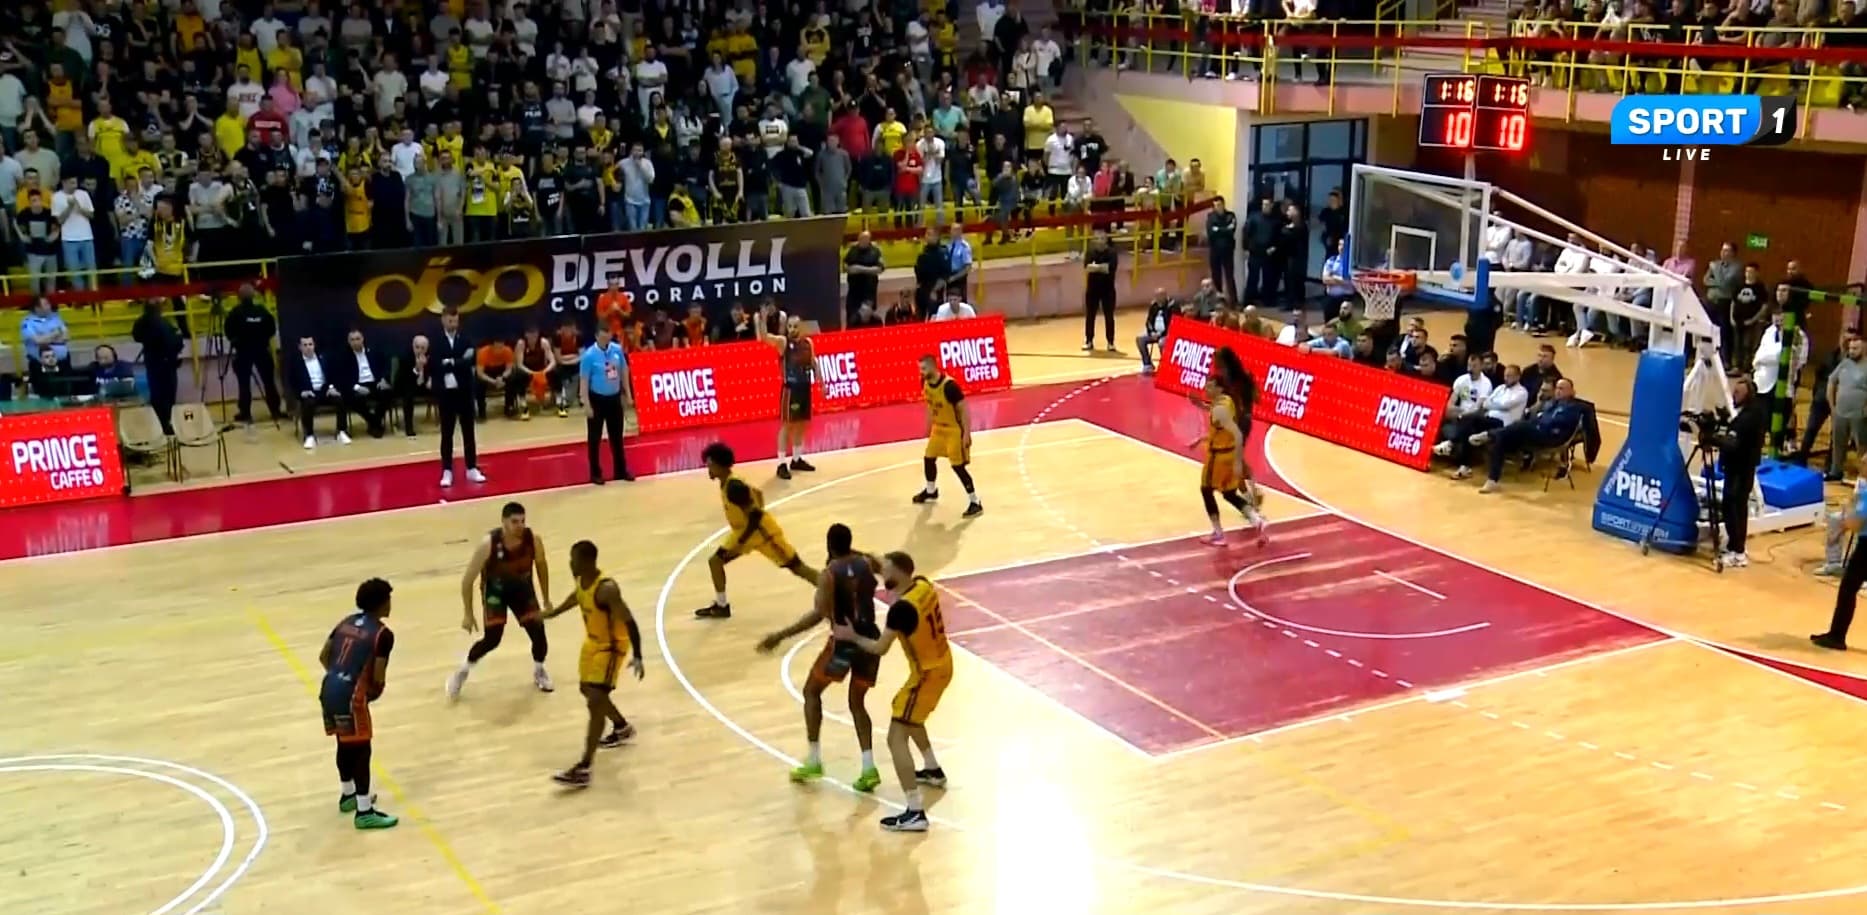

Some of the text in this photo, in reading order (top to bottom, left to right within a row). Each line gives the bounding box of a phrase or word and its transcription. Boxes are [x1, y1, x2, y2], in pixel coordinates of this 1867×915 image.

[1441, 80, 1474, 102] 1:16
[1494, 84, 1528, 106] 1:16
[1446, 112, 1471, 148] 10
[1499, 115, 1526, 151] 10
[551, 237, 787, 293] DEVOLLI
[551, 277, 786, 312] COPORATION
[810, 352, 858, 384] INCE
[940, 337, 997, 369] PRINCE
[1171, 338, 1214, 375] PRINCE
[651, 368, 716, 403] PRINCE
[964, 364, 991, 382] CAFFE
[1180, 370, 1202, 388] CAFFE
[1264, 364, 1313, 403] PRINCE
[679, 399, 709, 417] CAFFE
[1275, 398, 1298, 418] CAFFE
[1375, 396, 1432, 437] PRINCE
[11, 434, 101, 474] PRINCE
[1387, 432, 1413, 454] CAFFE
[50, 468, 92, 490] CAFFE
[1616, 471, 1662, 506] Pikë
